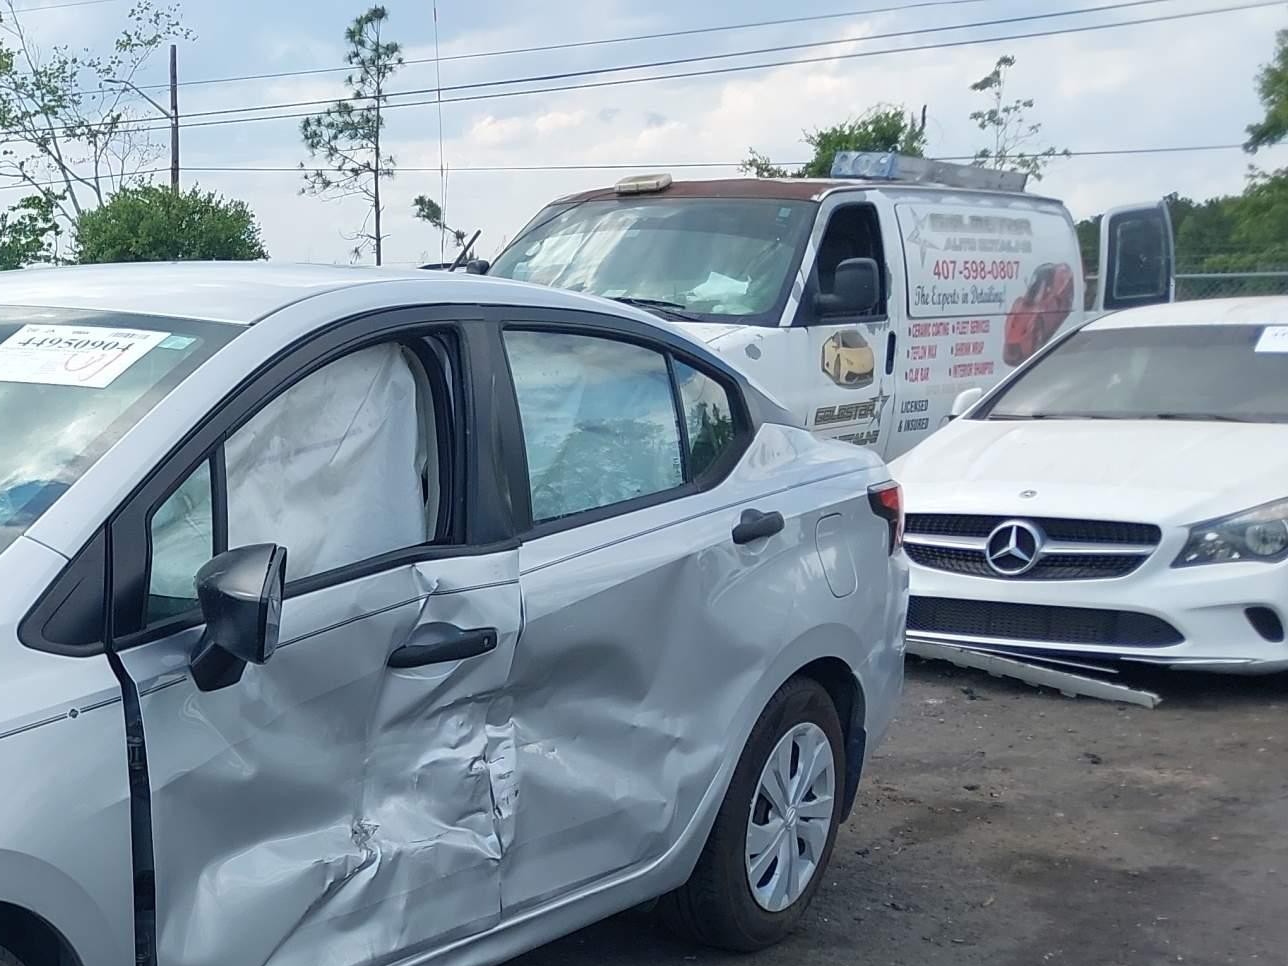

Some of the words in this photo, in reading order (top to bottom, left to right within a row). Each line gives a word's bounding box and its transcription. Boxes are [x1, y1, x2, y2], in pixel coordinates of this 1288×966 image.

[933, 260, 1020, 280] 407-598-0807
[915, 285, 930, 305] The
[961, 288, 969, 304] in
[18, 336, 135, 353] 44950904
[814, 401, 876, 425] GOLDSTAR
[900, 400, 929, 414] LICENSED
[898, 421, 903, 432] &
[904, 418, 929, 431] INSURED
